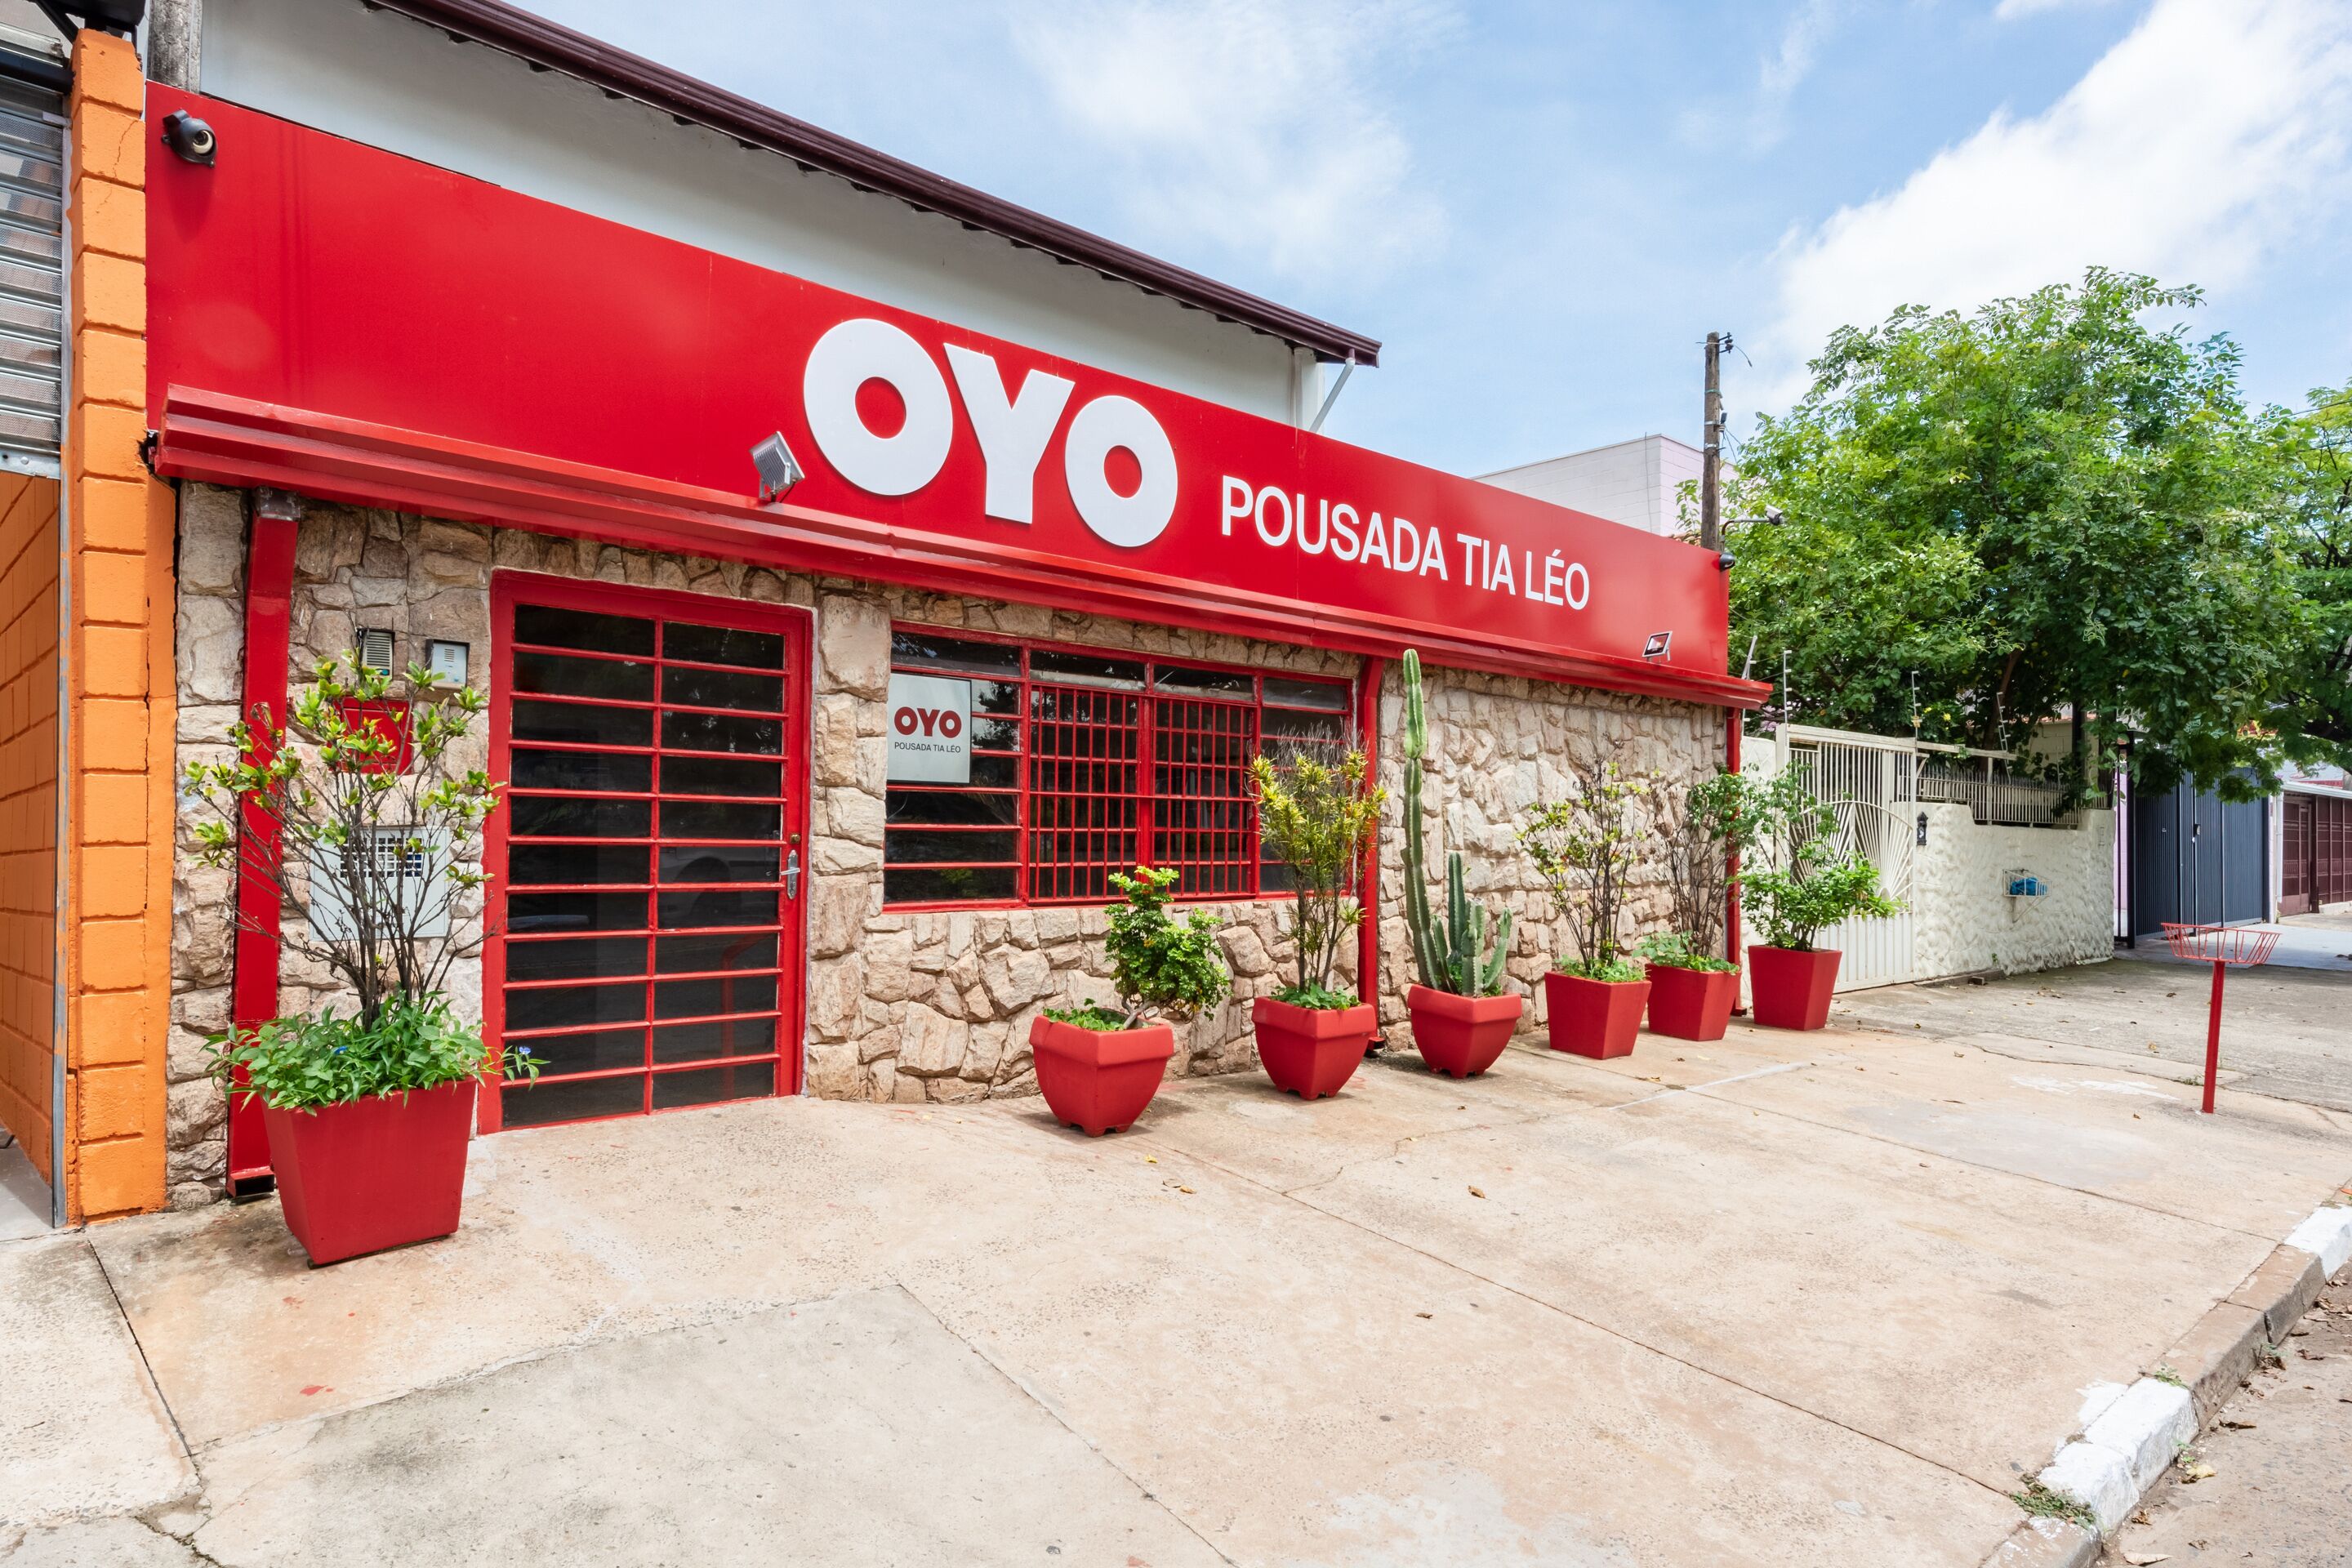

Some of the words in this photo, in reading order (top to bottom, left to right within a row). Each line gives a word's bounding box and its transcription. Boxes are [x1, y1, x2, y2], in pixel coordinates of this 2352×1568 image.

[804, 318, 1178, 548] OYO
[1222, 474, 1449, 581] POUSADA
[1456, 532, 1517, 596] TIA
[1525, 548, 1590, 611] LÉO
[894, 706, 962, 739] OYO
[894, 742, 932, 751] POUSADA
[933, 744, 945, 752] TIA
[946, 744, 961, 754] LÉO
